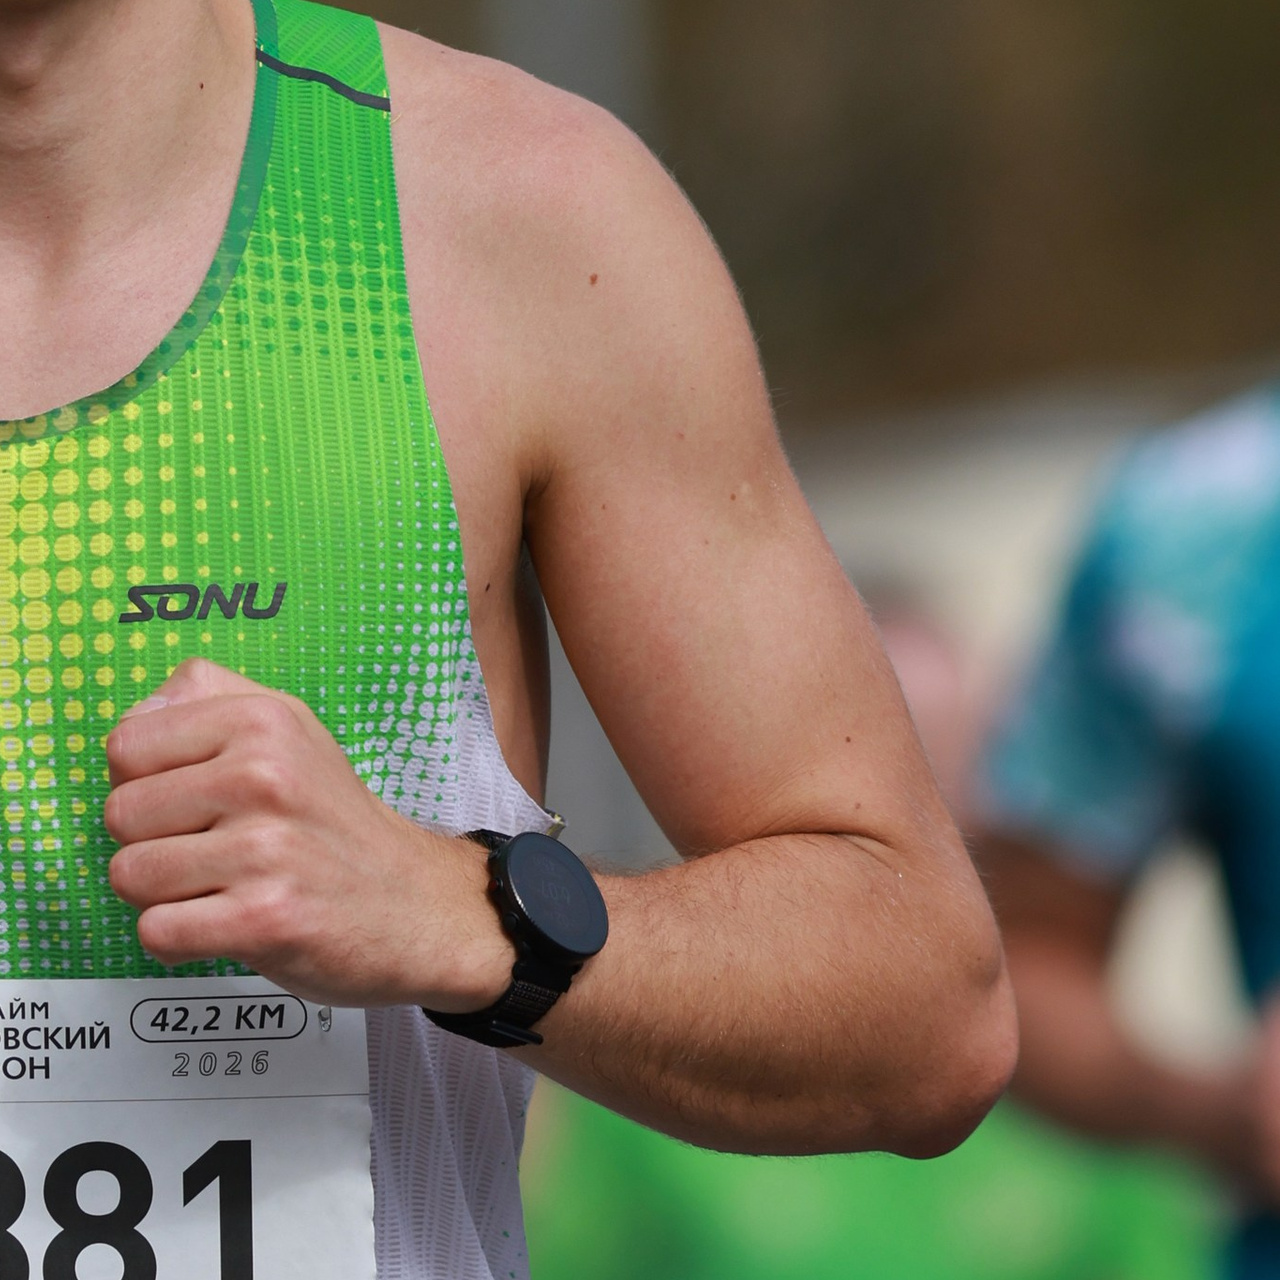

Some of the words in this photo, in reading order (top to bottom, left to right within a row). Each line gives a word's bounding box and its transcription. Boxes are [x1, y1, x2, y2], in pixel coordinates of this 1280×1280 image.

[118, 582, 288, 624] SONU
[149, 1006, 222, 1033] 42,2
[234, 1004, 286, 1030] КМ
[171, 1050, 271, 1077] 2026
